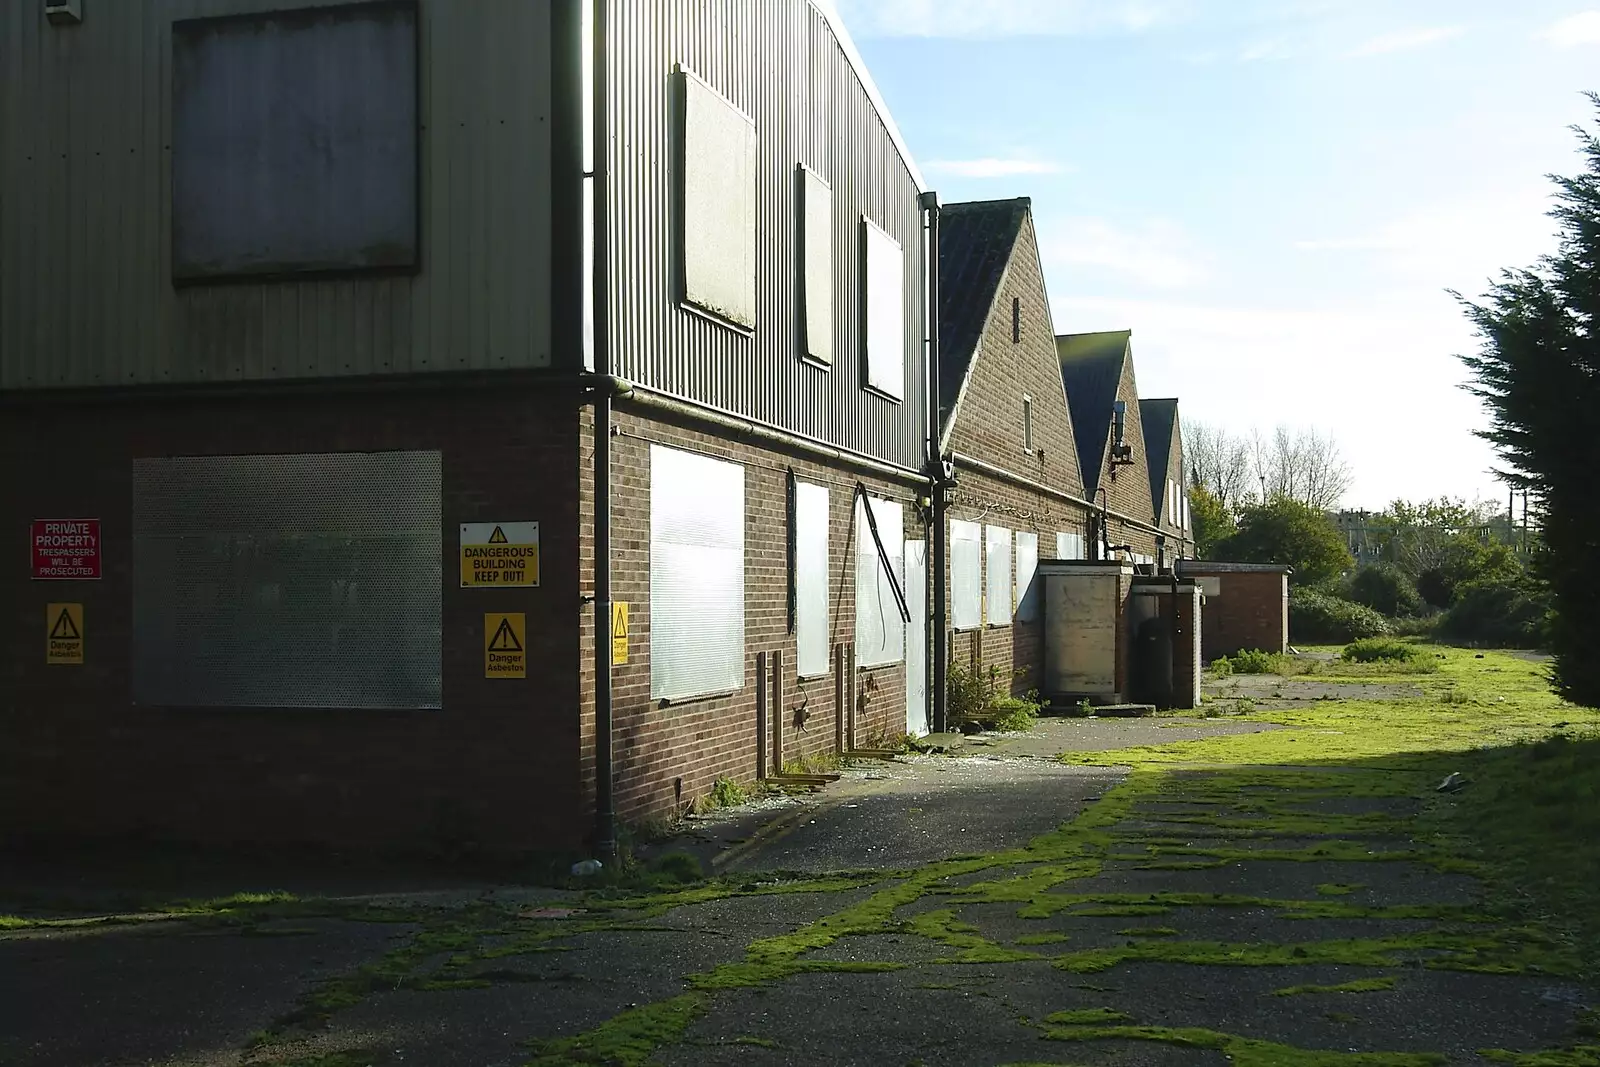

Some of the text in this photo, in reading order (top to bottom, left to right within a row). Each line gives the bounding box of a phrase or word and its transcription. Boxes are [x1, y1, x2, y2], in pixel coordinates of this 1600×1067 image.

[45, 523, 90, 534] PRIVATE
[36, 535, 96, 546] PROPERTY
[38, 548, 95, 556] TRESPASSERS
[464, 547, 534, 557] DANGEROUS
[51, 558, 84, 566] WILL BE
[473, 559, 526, 569] BUILDING
[39, 567, 94, 576] PROSECUTED
[475, 571, 524, 582] KEEP OUT!
[51, 640, 80, 650] Danger
[489, 653, 522, 664] Danger
[487, 664, 524, 672] Asbestos
